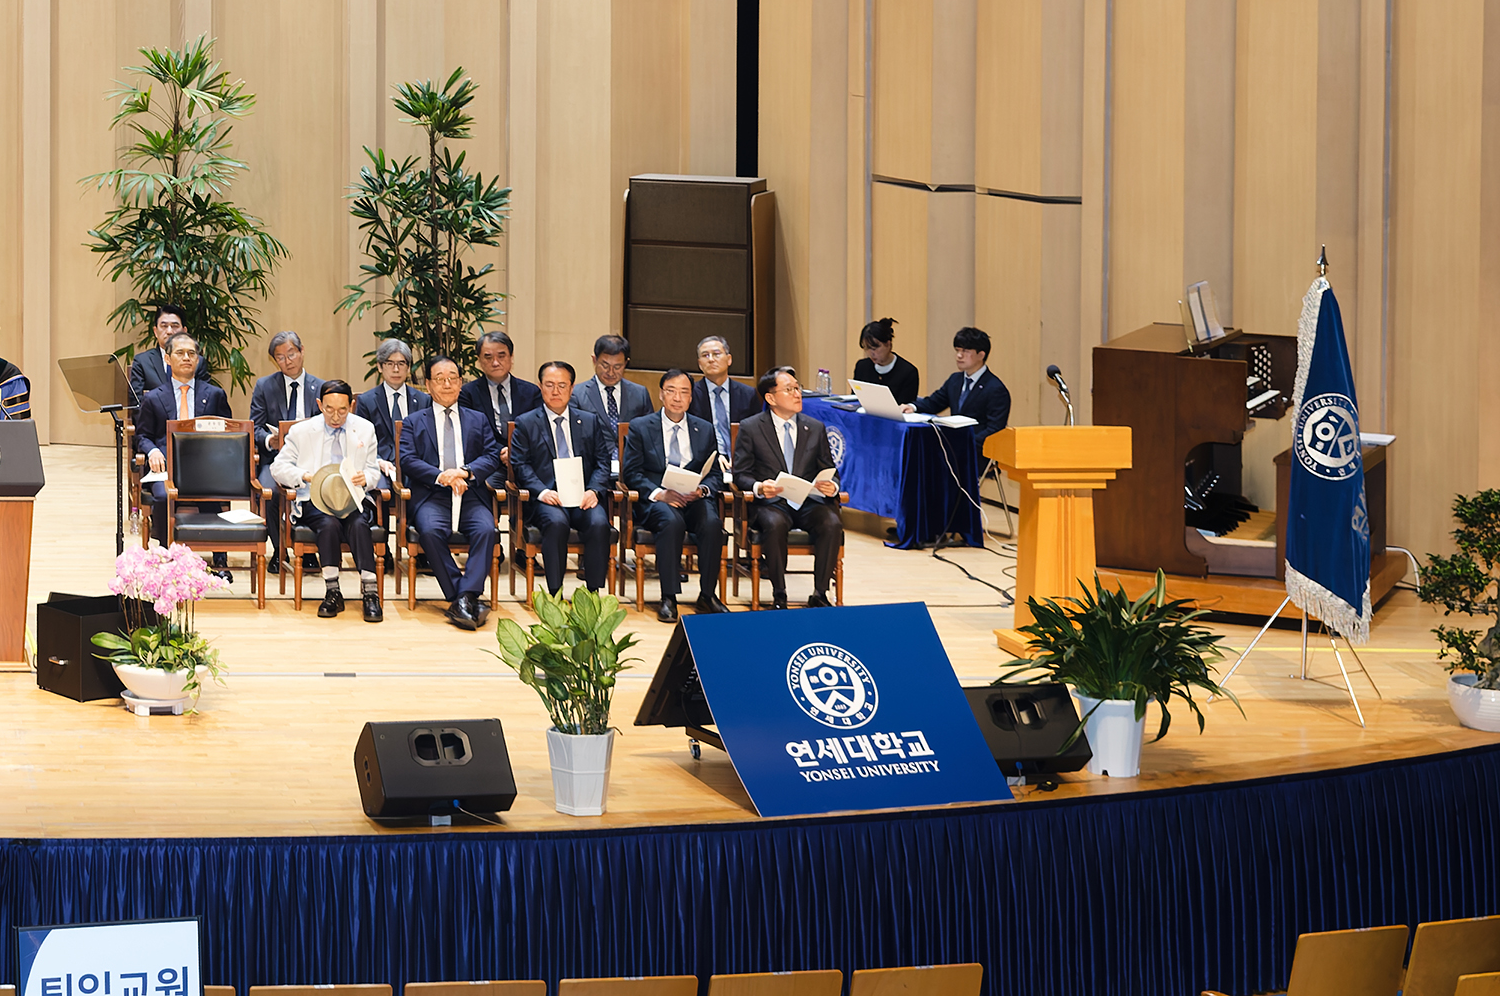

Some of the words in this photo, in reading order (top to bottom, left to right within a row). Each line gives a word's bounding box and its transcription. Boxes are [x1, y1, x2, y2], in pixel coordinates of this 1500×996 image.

[790, 652, 808, 690] YONSEI
[807, 646, 871, 684] UNIVERSITY
[785, 730, 935, 767] 연세대학교
[800, 767, 856, 783] YONSEI
[855, 760, 941, 778] UNIVERSITY
